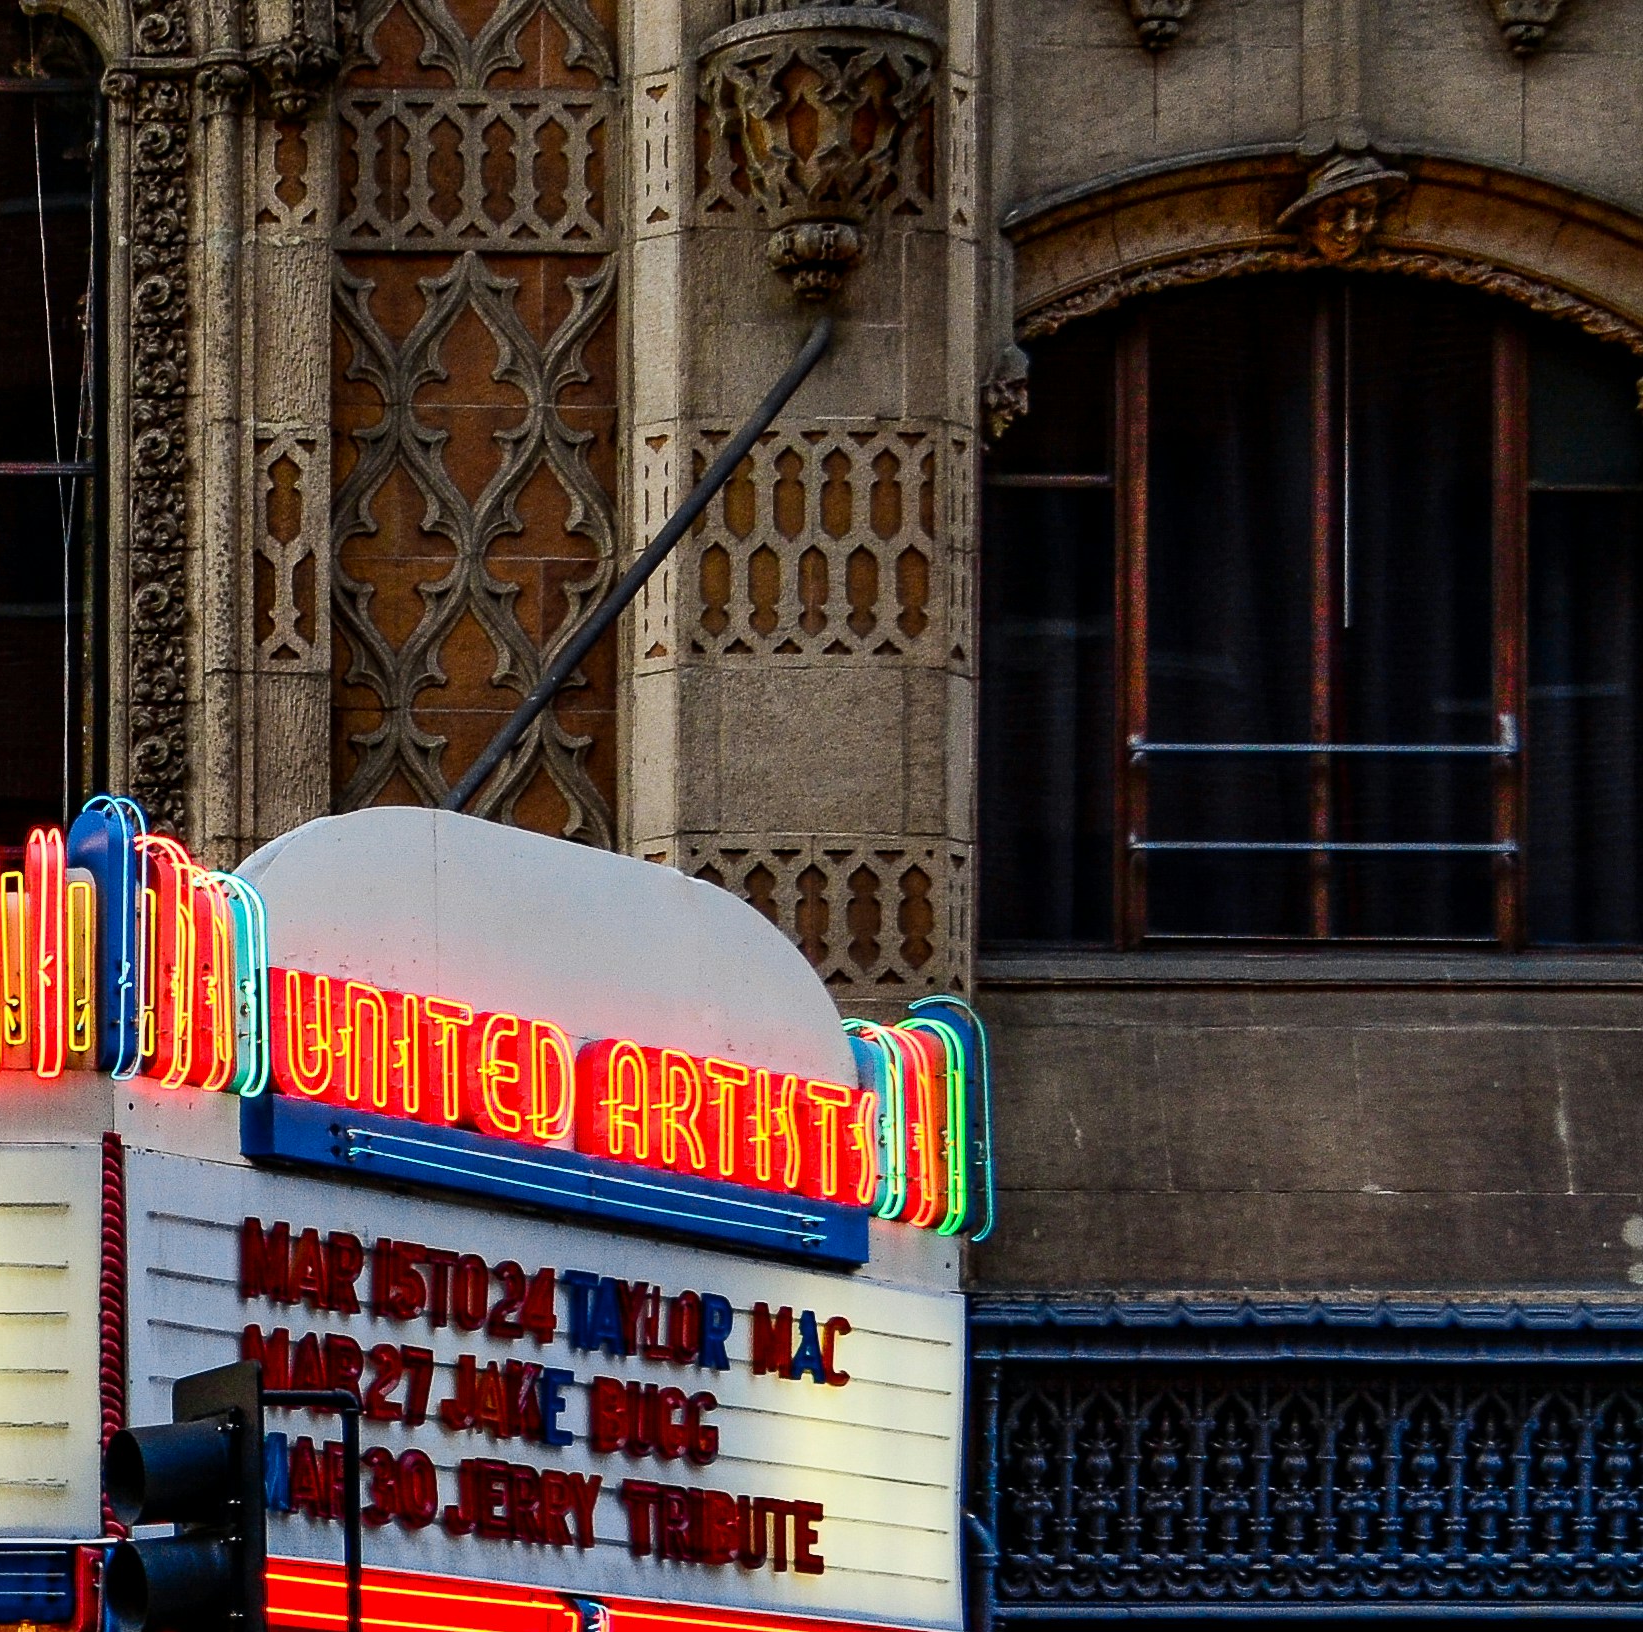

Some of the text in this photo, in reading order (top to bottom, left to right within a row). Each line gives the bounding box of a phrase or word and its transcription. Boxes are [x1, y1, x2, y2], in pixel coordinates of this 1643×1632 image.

[271, 967, 877, 1206] UNITED ARTISTS
[241, 1216, 363, 1314] MAR
[561, 1268, 733, 1371] TAYLOR
[751, 1301, 852, 1386] MAC
[440, 1353, 574, 1446] JAKE
[590, 1375, 719, 1465] BUGG
[443, 1457, 603, 1548] JERRY
[620, 1477, 825, 1576] TRIBUTE
